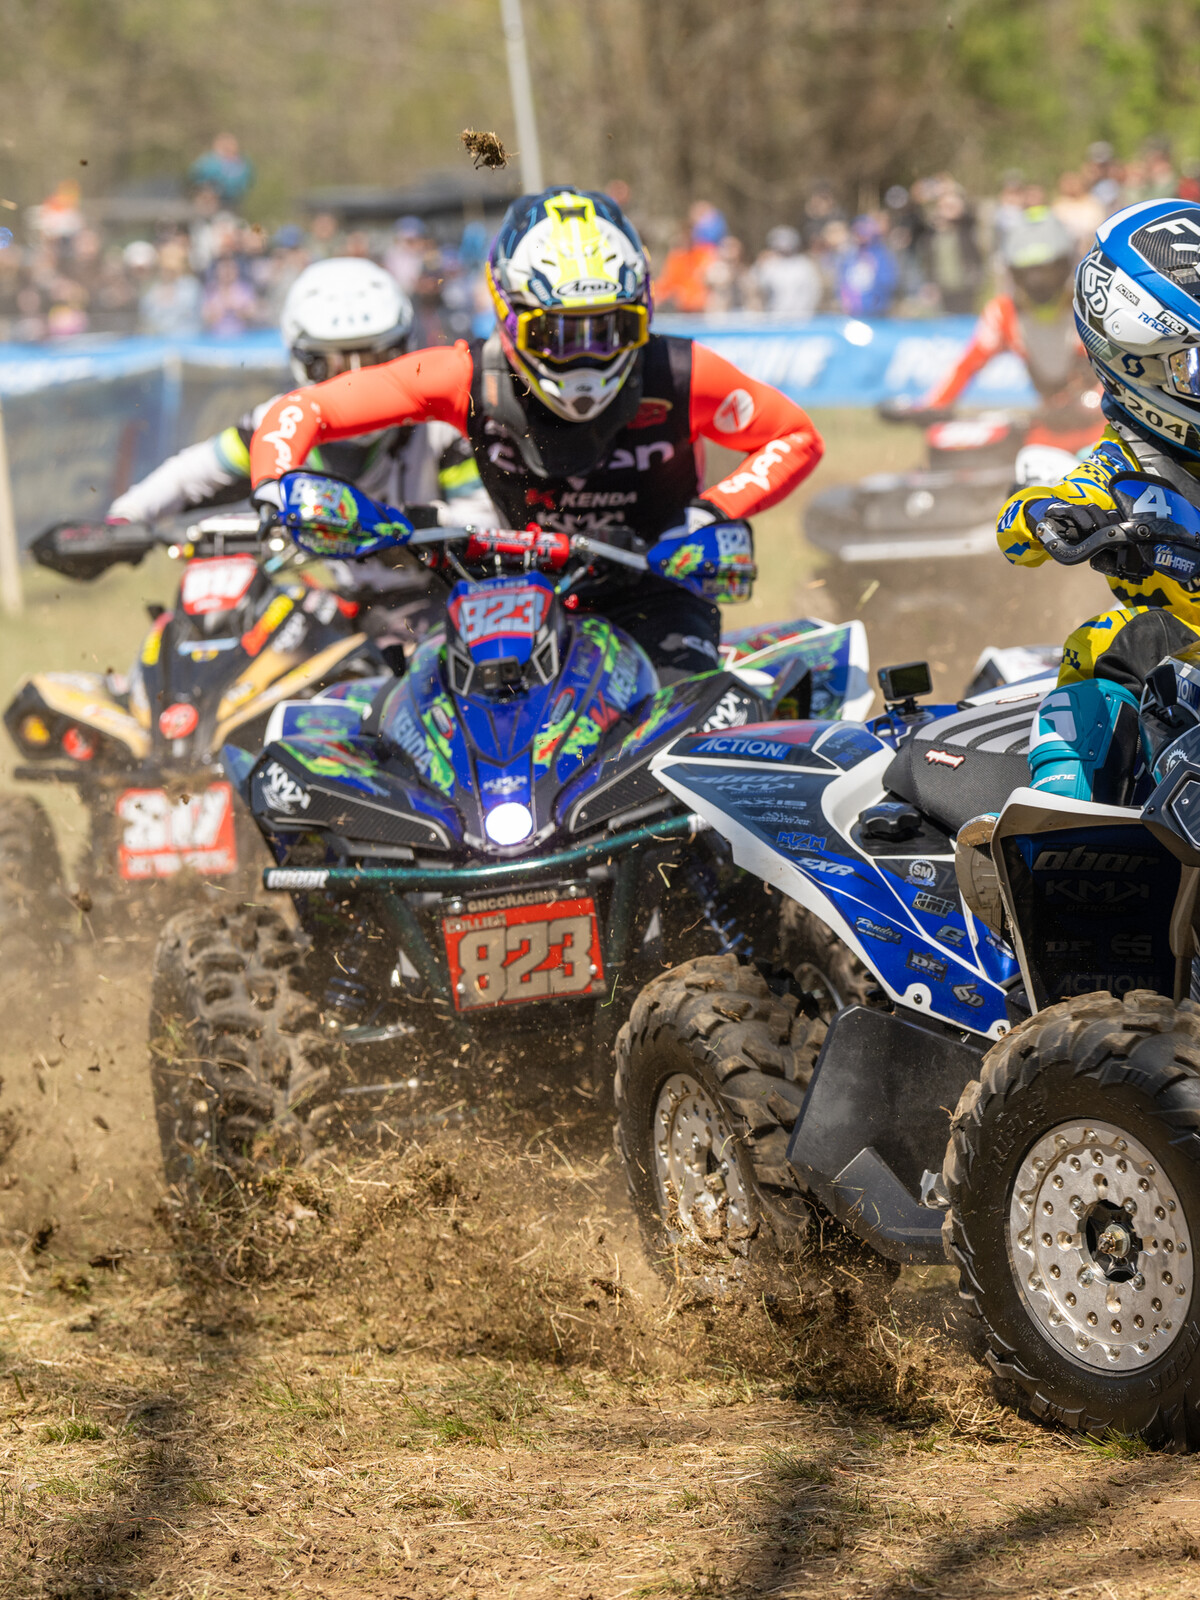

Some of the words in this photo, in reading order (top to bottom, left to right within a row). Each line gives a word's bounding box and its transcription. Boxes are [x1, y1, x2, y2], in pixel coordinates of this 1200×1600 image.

[564, 280, 610, 292] Arai
[1116, 284, 1140, 305] ACTION
[1138, 312, 1172, 336] RACE
[1156, 311, 1187, 334] PRO
[1126, 398, 1185, 440] 204
[560, 491, 638, 508] KENDA
[1132, 484, 1173, 520] 4
[1155, 553, 1196, 573] WHARFF
[458, 594, 546, 643] 823
[698, 738, 780, 758] ACTION
[776, 831, 827, 850] MZM
[798, 857, 855, 877] FXR
[459, 917, 593, 1008] 823
